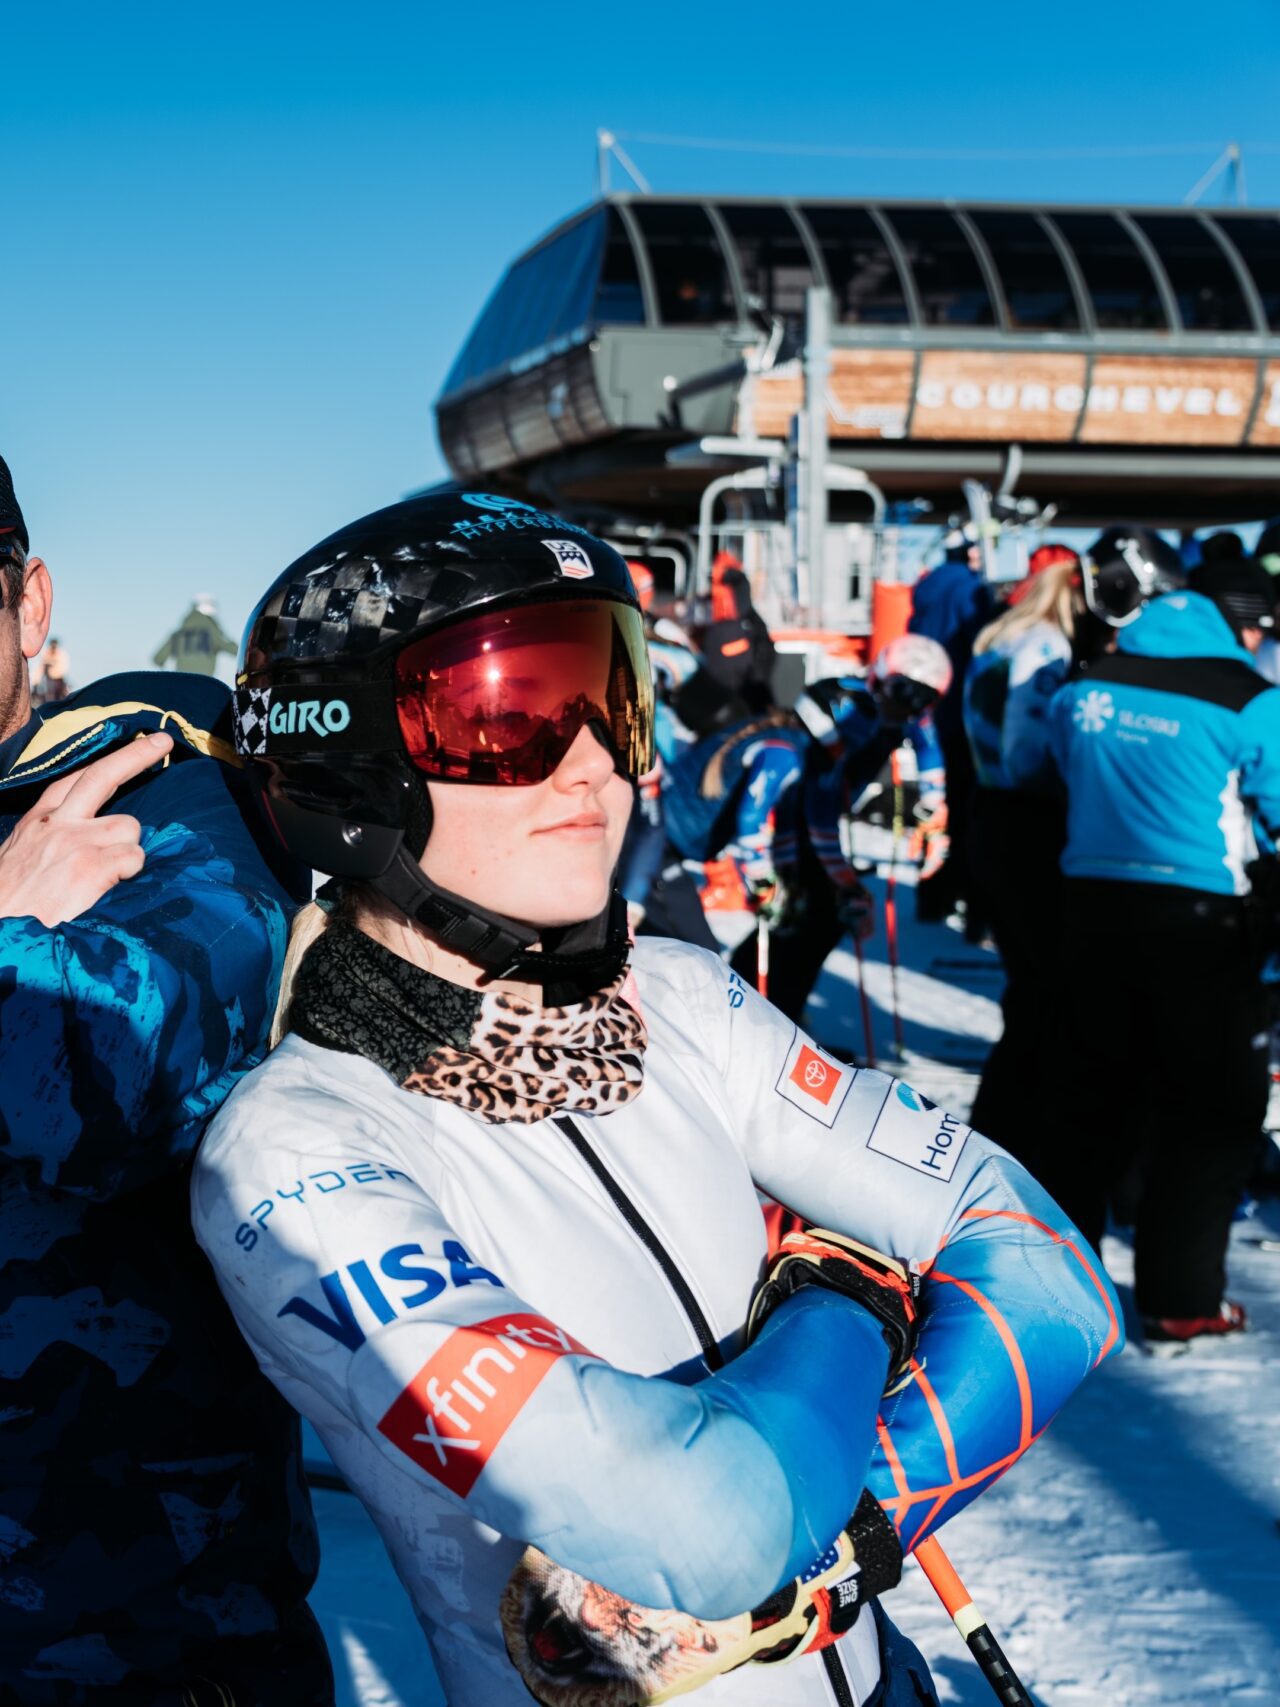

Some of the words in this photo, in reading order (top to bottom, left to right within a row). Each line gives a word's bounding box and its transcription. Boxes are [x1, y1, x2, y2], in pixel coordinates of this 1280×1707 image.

[916, 382, 1241, 415] COURCHEVEL
[545, 541, 578, 552] US
[269, 699, 351, 738] GIRO
[235, 1162, 414, 1252] SPYDER
[277, 1239, 505, 1353] VISA
[411, 1321, 575, 1467] xfinity
[836, 1578, 859, 1597] SIZE
[839, 1591, 859, 1608] ONE
